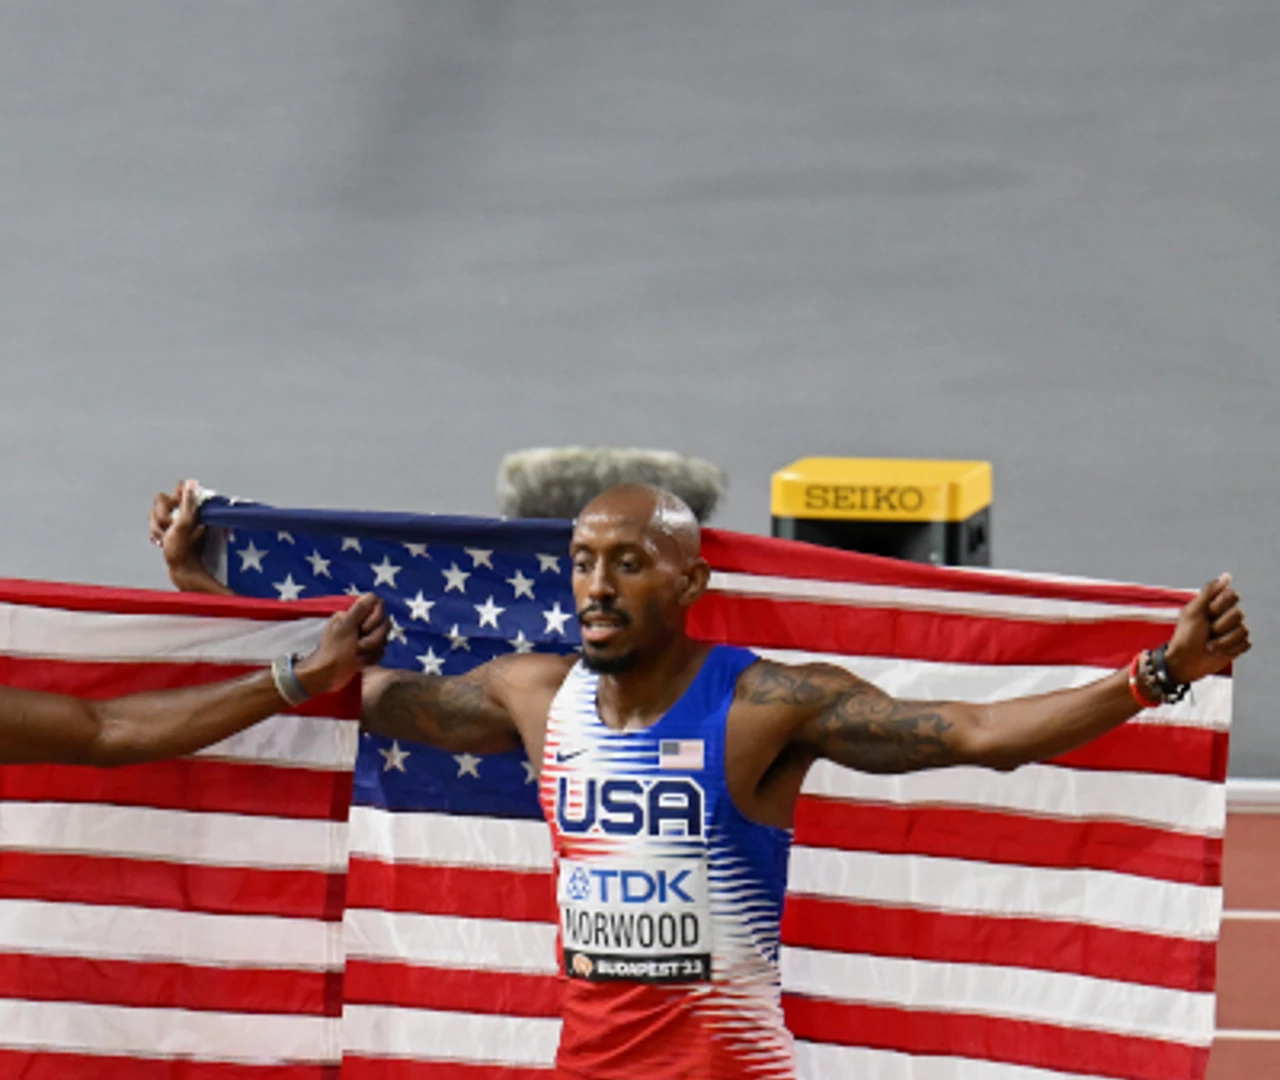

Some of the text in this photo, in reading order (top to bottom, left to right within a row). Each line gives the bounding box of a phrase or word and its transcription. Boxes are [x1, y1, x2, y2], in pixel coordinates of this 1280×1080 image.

[804, 483, 924, 512] SEIKO
[557, 777, 702, 836] USA
[590, 869, 696, 903] TDK
[565, 907, 700, 948] NORWOOD
